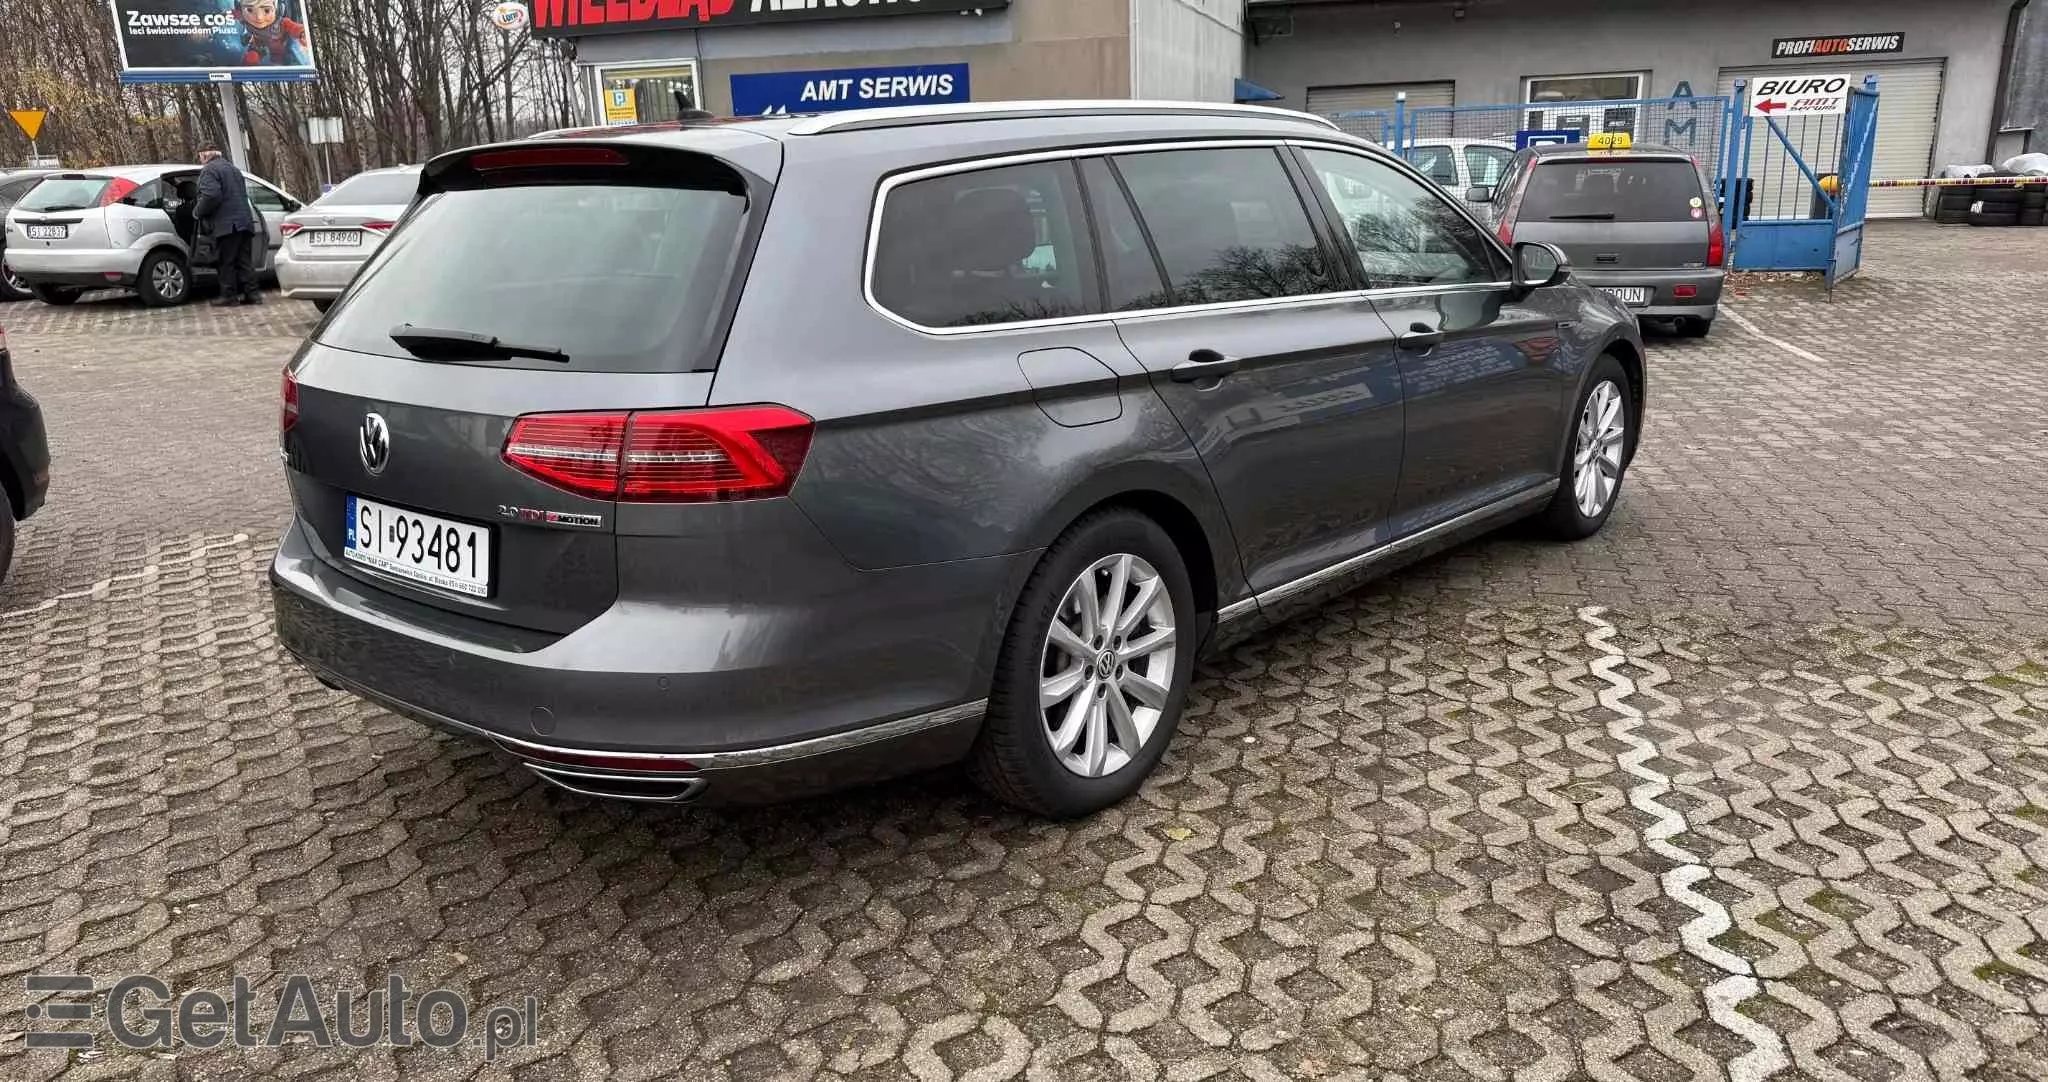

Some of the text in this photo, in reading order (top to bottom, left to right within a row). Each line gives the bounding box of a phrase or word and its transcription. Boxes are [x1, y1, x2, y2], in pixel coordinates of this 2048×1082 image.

[126, 10, 235, 26] Zawsze coś
[1775, 35, 1900, 56] PROFIAUTOSERWIS
[801, 74, 953, 102] AMT SERWIS
[1756, 78, 1846, 96] BIURO
[360, 506, 382, 553] SI
[396, 515, 476, 578] 93481
